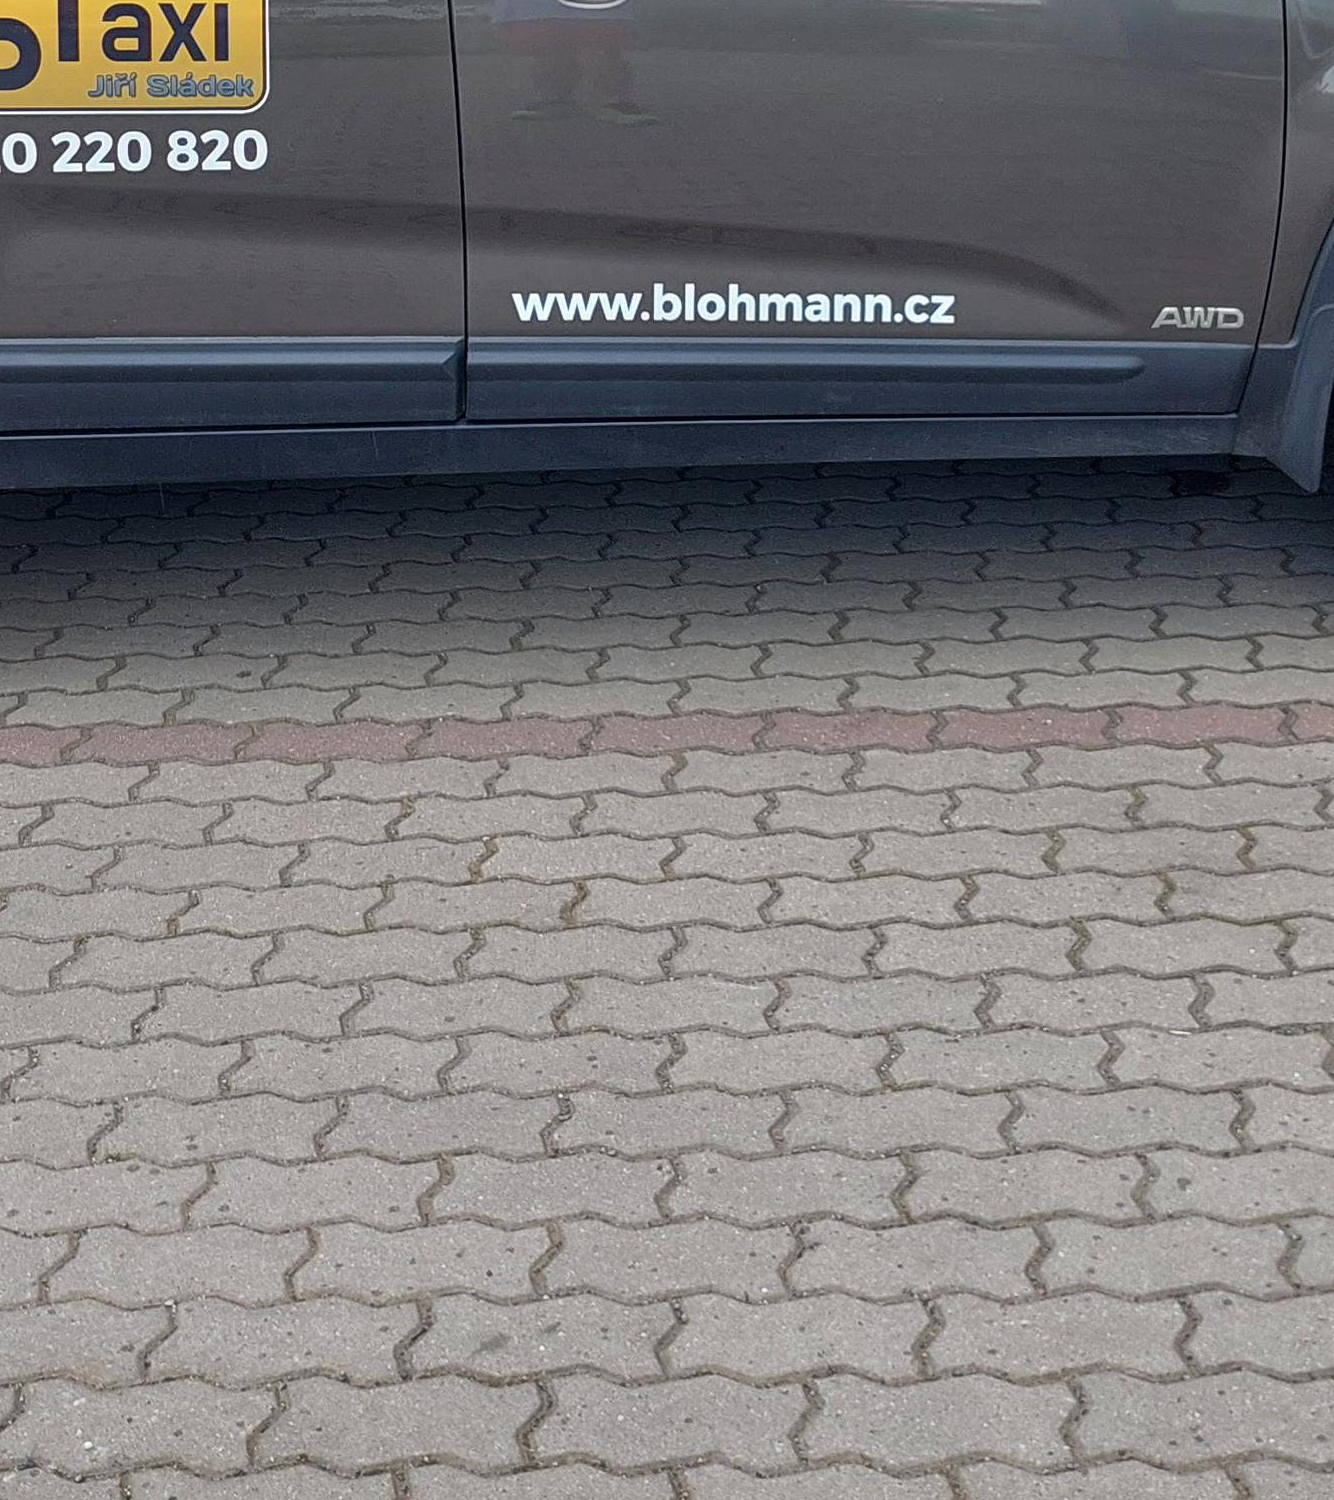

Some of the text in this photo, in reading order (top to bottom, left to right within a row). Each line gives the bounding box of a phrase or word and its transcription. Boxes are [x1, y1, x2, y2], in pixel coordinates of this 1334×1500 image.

[87, 72, 255, 98] Jiří Sládek
[51, 131, 152, 172] 220
[167, 129, 268, 171] 820
[510, 283, 957, 325] www.blohmann.cz
[1150, 305, 1245, 330] AWD
